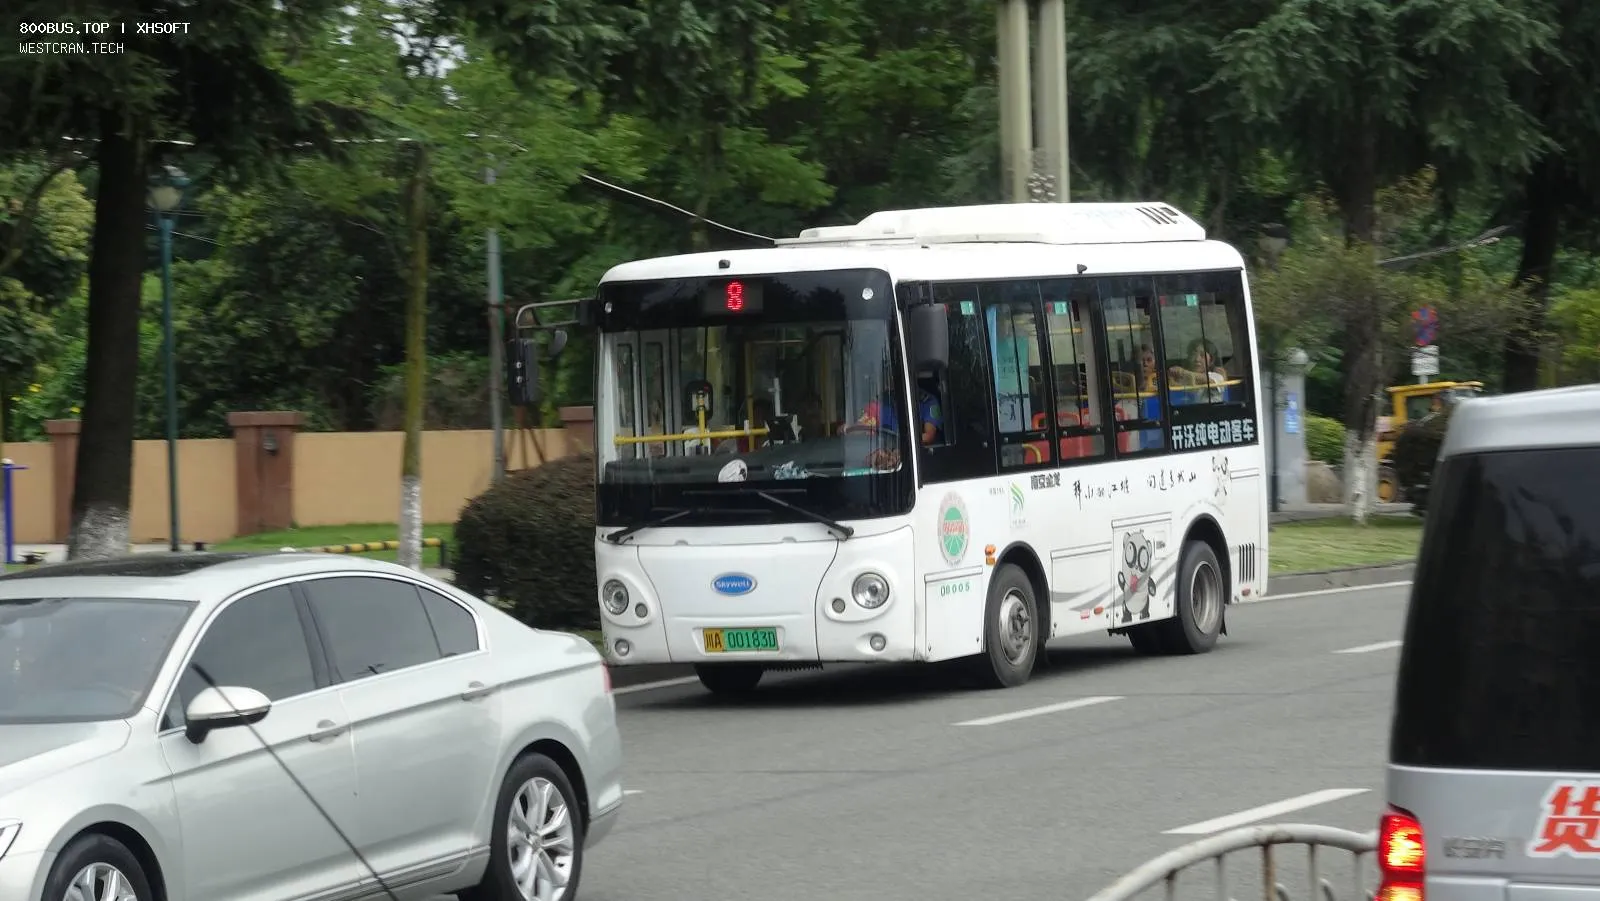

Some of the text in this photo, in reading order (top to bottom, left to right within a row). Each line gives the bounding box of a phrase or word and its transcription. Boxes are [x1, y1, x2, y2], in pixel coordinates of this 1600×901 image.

[727, 281, 742, 310] 8
[1171, 418, 1255, 450] 开沃纯电动客车
